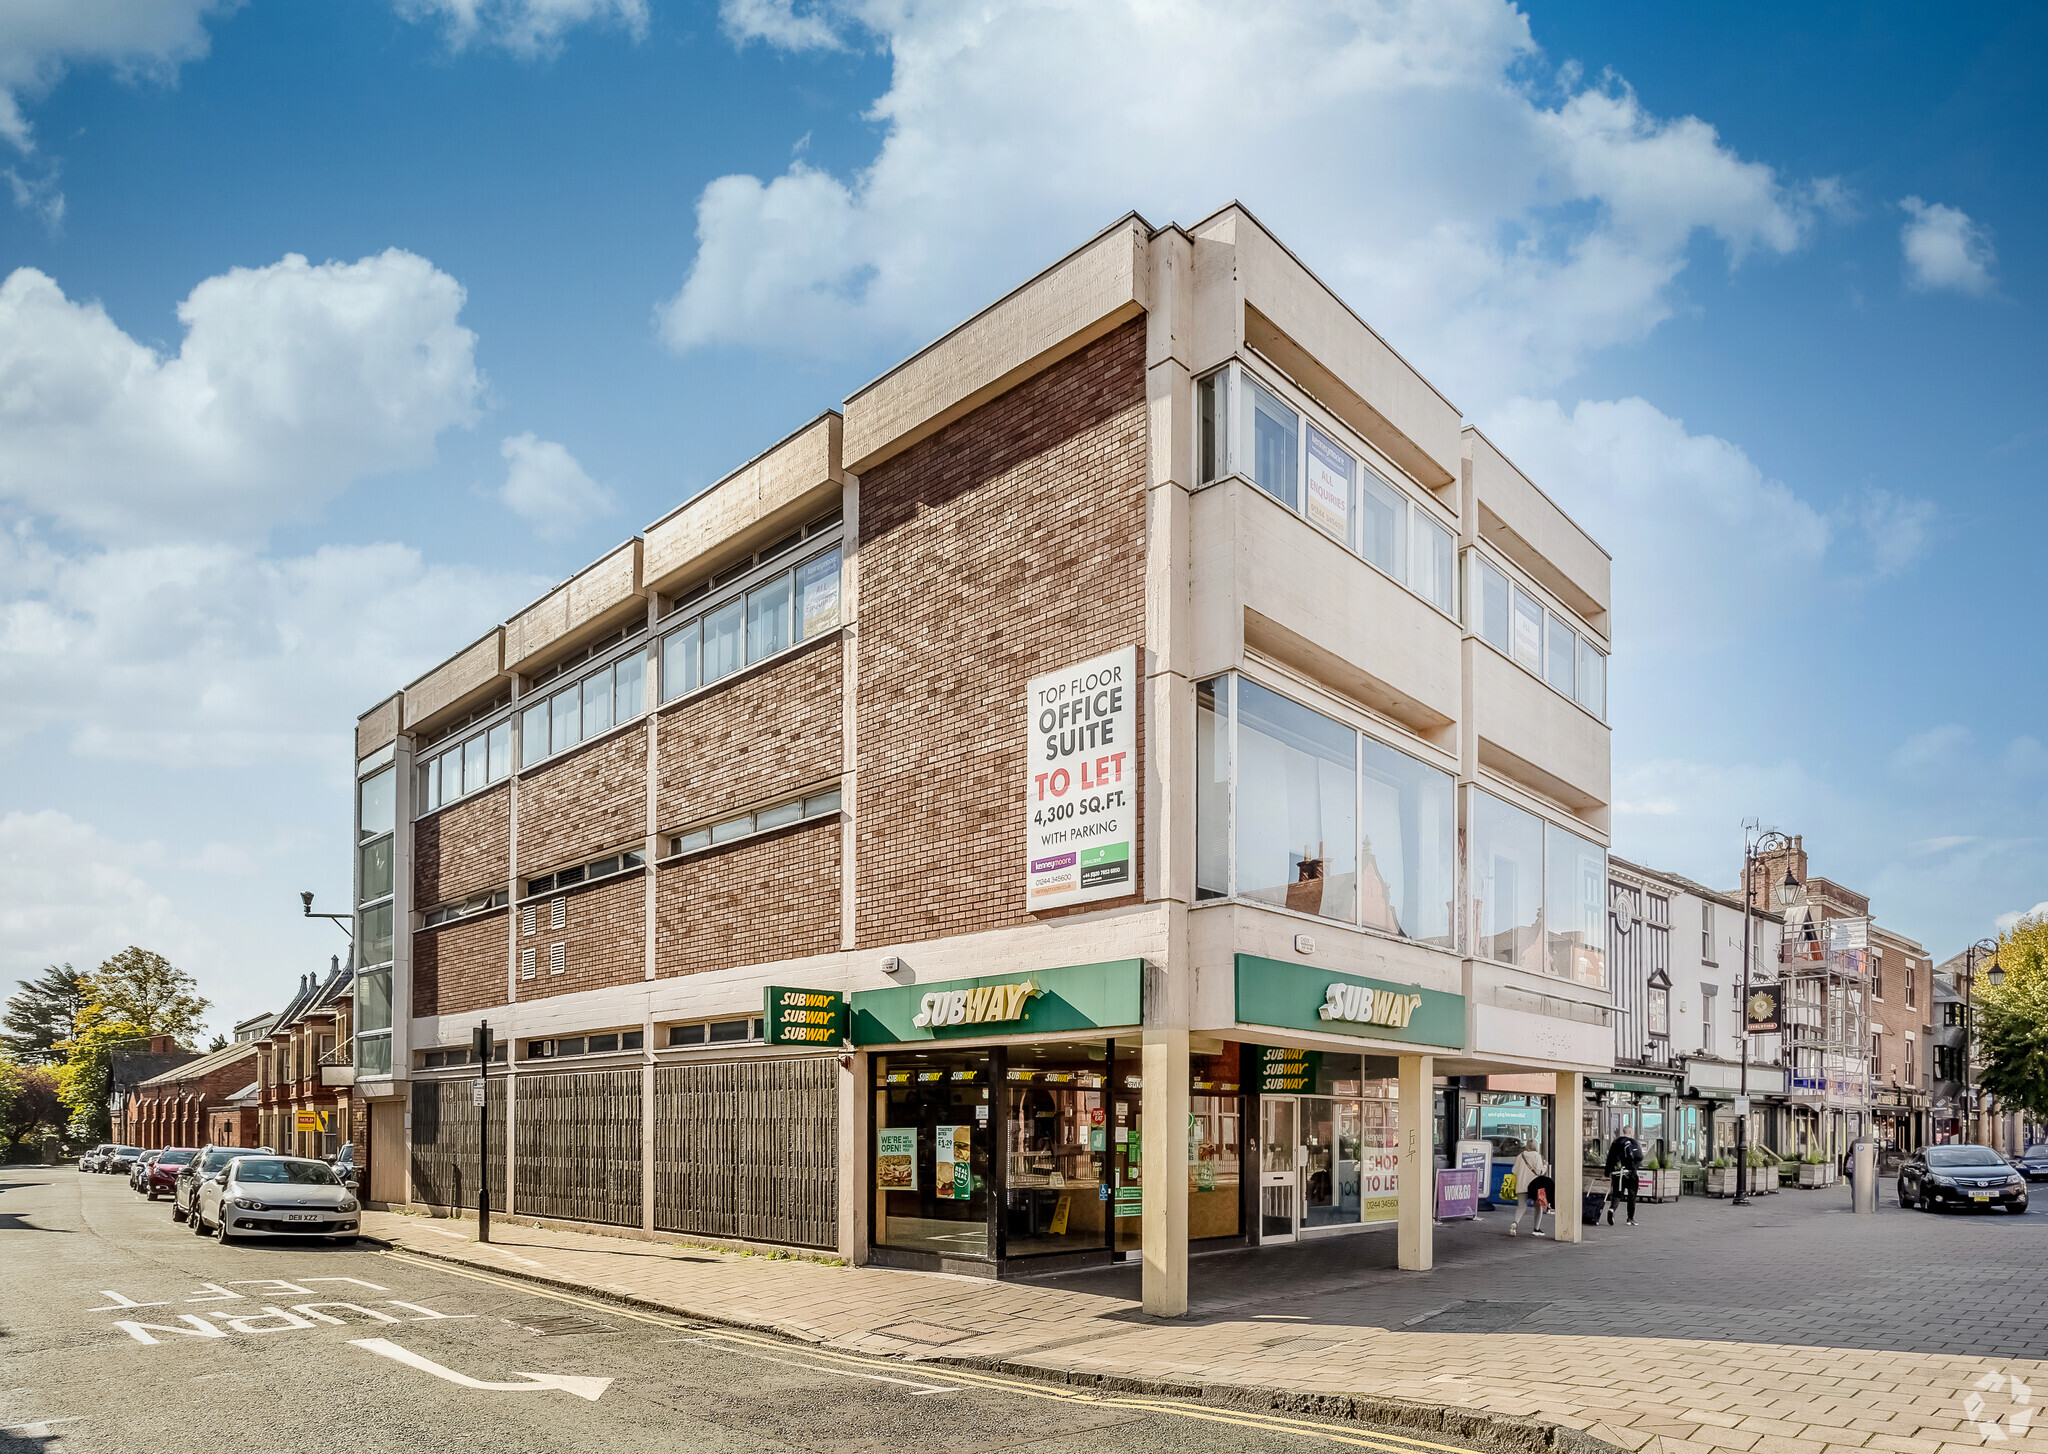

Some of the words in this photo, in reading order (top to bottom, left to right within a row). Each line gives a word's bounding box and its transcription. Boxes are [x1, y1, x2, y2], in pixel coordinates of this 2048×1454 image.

[1321, 470, 1334, 487] ALL
[1310, 479, 1346, 511] ENQUIRIES
[1038, 684, 1066, 707] TOP
[1071, 665, 1122, 697] FLOOR
[1039, 686, 1123, 734] OFFICE
[1046, 718, 1114, 761] SUITE
[1034, 768, 1071, 801] TO
[1081, 751, 1127, 791] LET
[1034, 803, 1074, 827] 4,300
[1079, 790, 1127, 815] SQ.FT.
[1041, 828, 1067, 846] WITH
[1070, 819, 1118, 842] PARKING
[1035, 857, 1072, 871] kenneymoore
[1035, 877, 1051, 886] 01244
[780, 992, 835, 1007] SUBWAY
[912, 979, 1041, 1029] SUBWAY
[1319, 983, 1422, 1028] SUBWAY
[780, 1009, 835, 1025] SUBWAY
[780, 1026, 836, 1042] SUBWAY
[1263, 1049, 1308, 1061] SUBWAY
[918, 1072, 942, 1082] SUBWAY
[951, 1070, 977, 1080] SUBWAY
[1007, 1071, 1036, 1080] SUBWAY
[1263, 1063, 1309, 1076] SUBWAY
[886, 1073, 910, 1082] SUBWAY
[1045, 1073, 1069, 1082] SUBWAY
[1263, 1078, 1309, 1090] SUBWAY
[1193, 1081, 1214, 1090] SUBWAY
[1221, 1083, 1240, 1091] SUBWAY
[881, 1136, 902, 1144] WE'RE
[881, 1144, 902, 1152] OPEN!
[955, 1166, 968, 1175] REAL
[1368, 1155, 1398, 1171] SHOP
[955, 1171, 967, 1180] DEAL
[1366, 1175, 1381, 1192] TO
[1445, 1184, 1471, 1201] WOK&GO
[1366, 1201, 1381, 1210] 01244
[86, 1277, 390, 1312] LEFT
[113, 1301, 478, 1345] TURN
